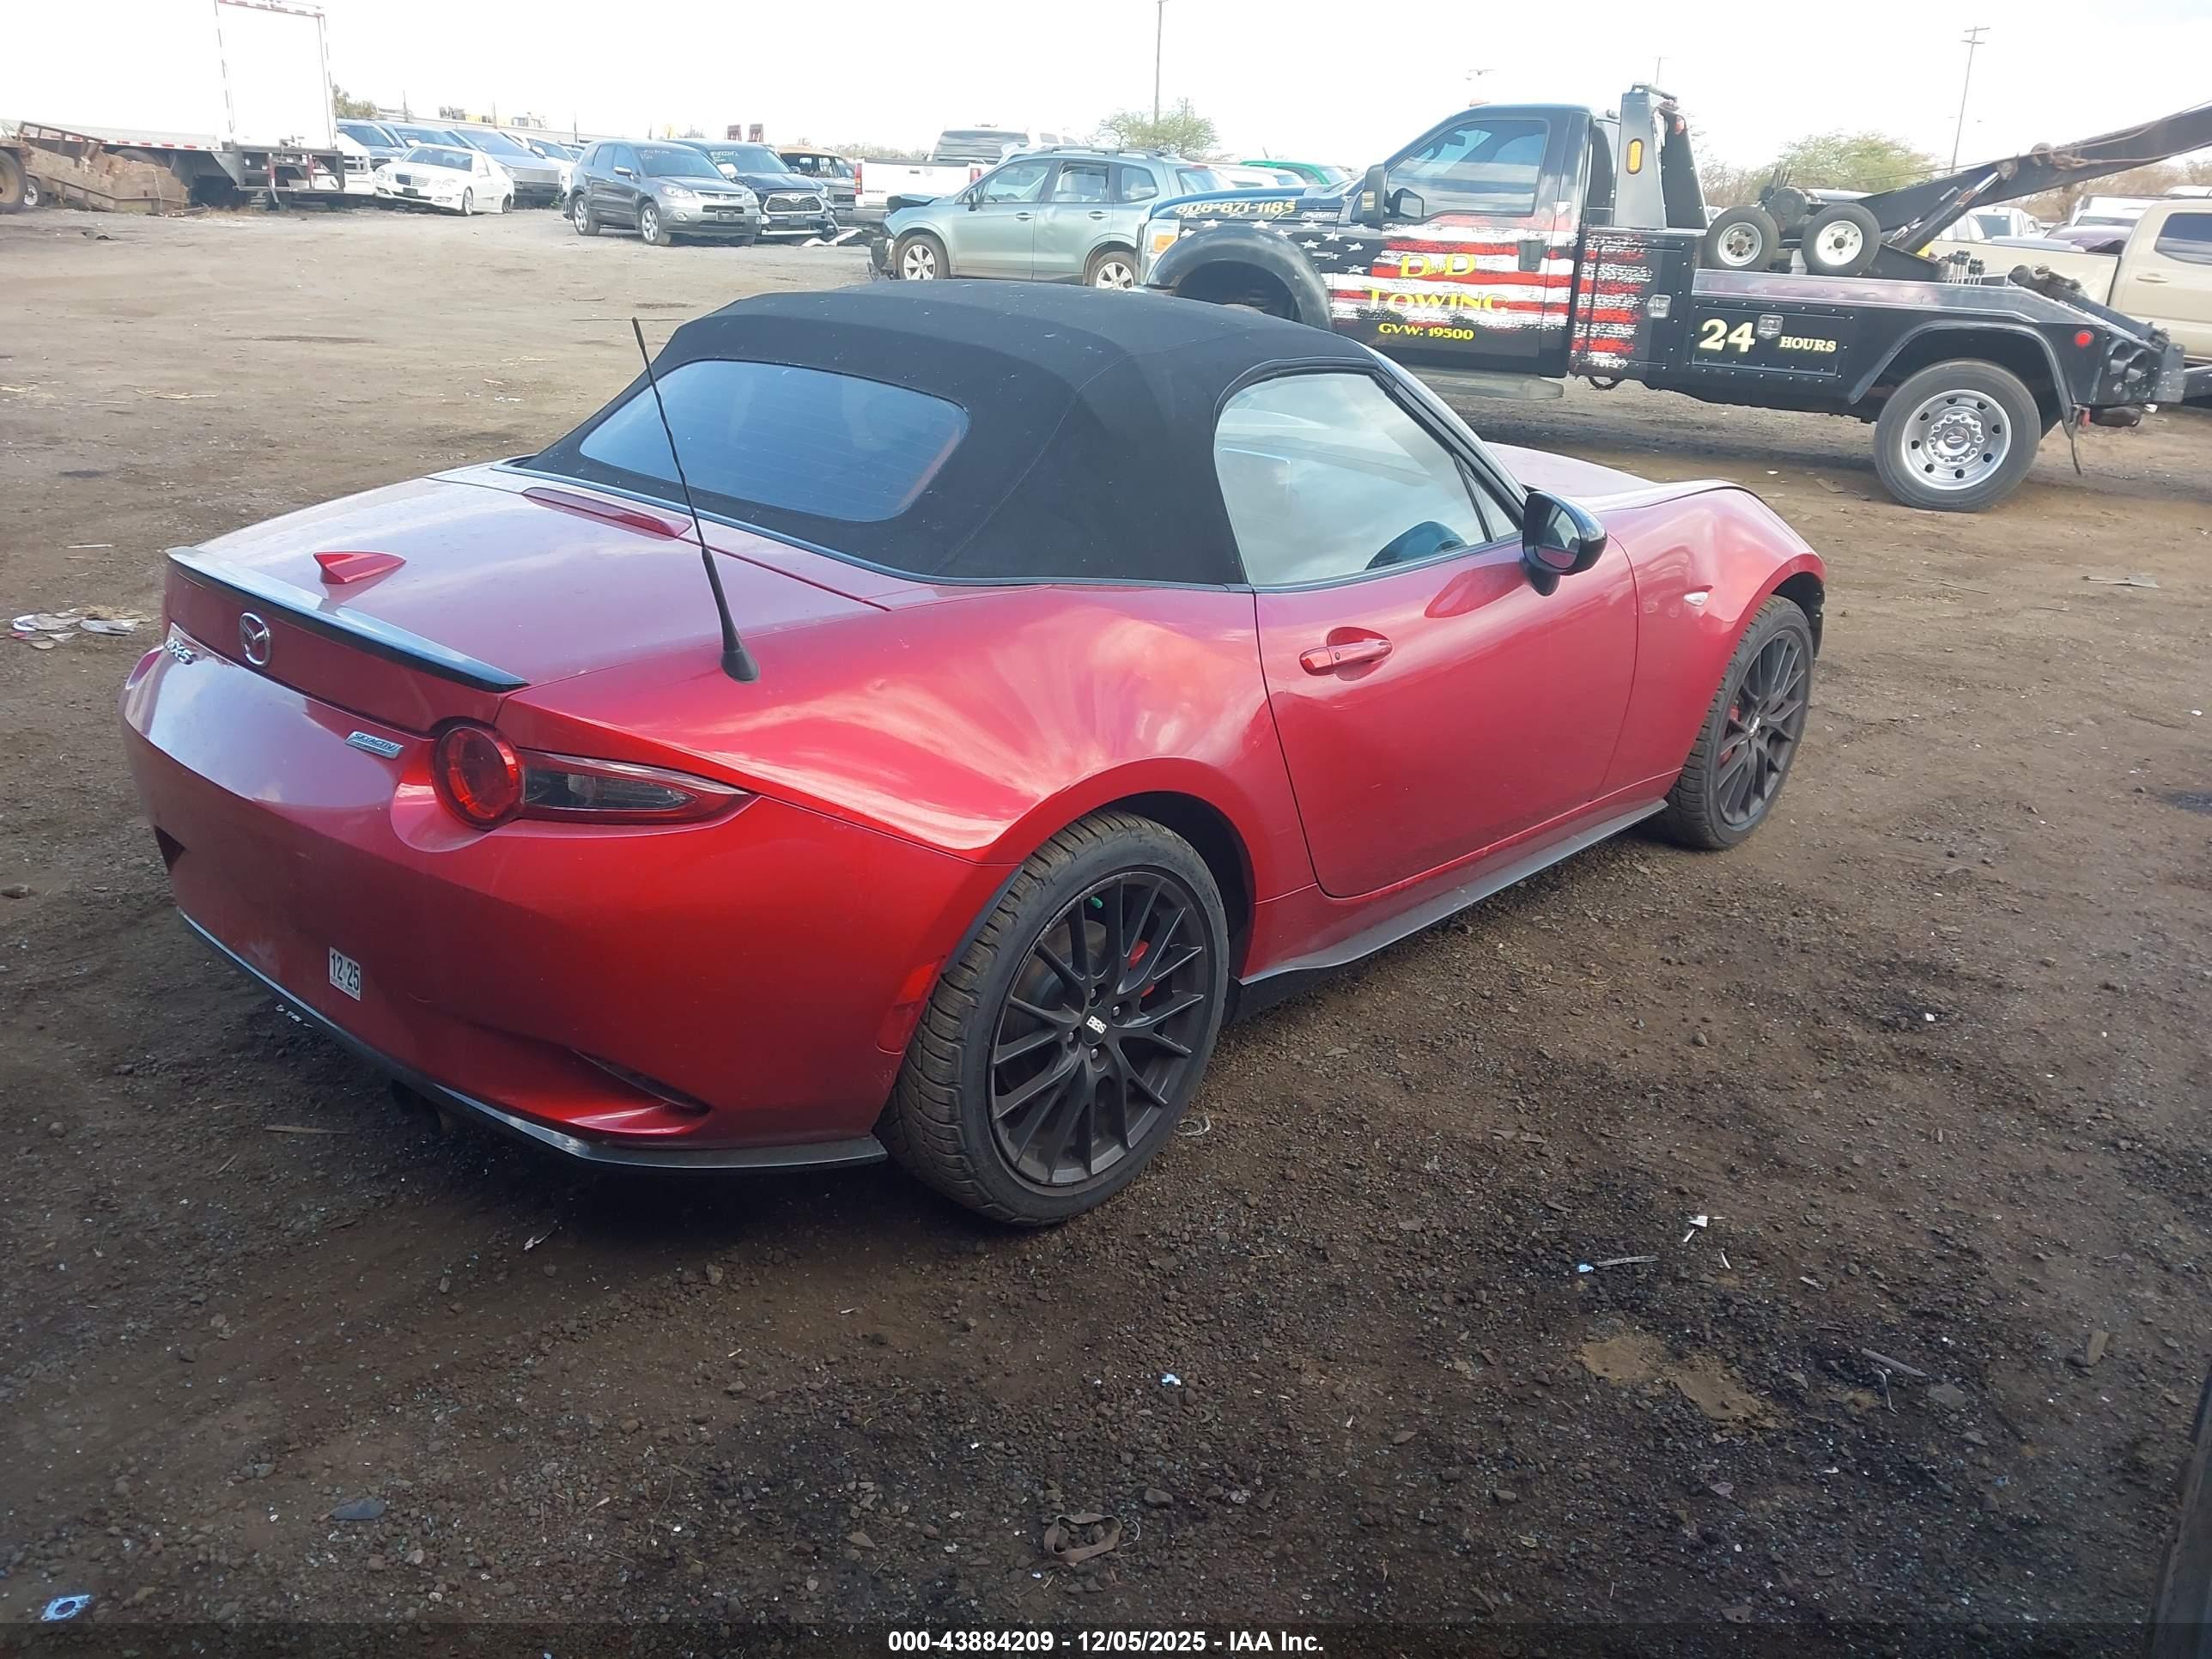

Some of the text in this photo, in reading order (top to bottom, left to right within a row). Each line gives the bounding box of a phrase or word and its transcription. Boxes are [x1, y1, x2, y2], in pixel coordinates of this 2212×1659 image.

[1176, 200, 1297, 215] 808-871-1185
[1399, 254, 1431, 278] D
[1444, 252, 1477, 276] D
[1363, 285, 1510, 316] TOWING
[1377, 322, 1475, 341] GVW: 19500
[1698, 318, 1838, 353] 24 HOURS
[353, 732, 397, 750] SKYACTIV
[331, 952, 343, 981] 12
[347, 961, 360, 992] 25
[1085, 1015, 1108, 1035] BBS
